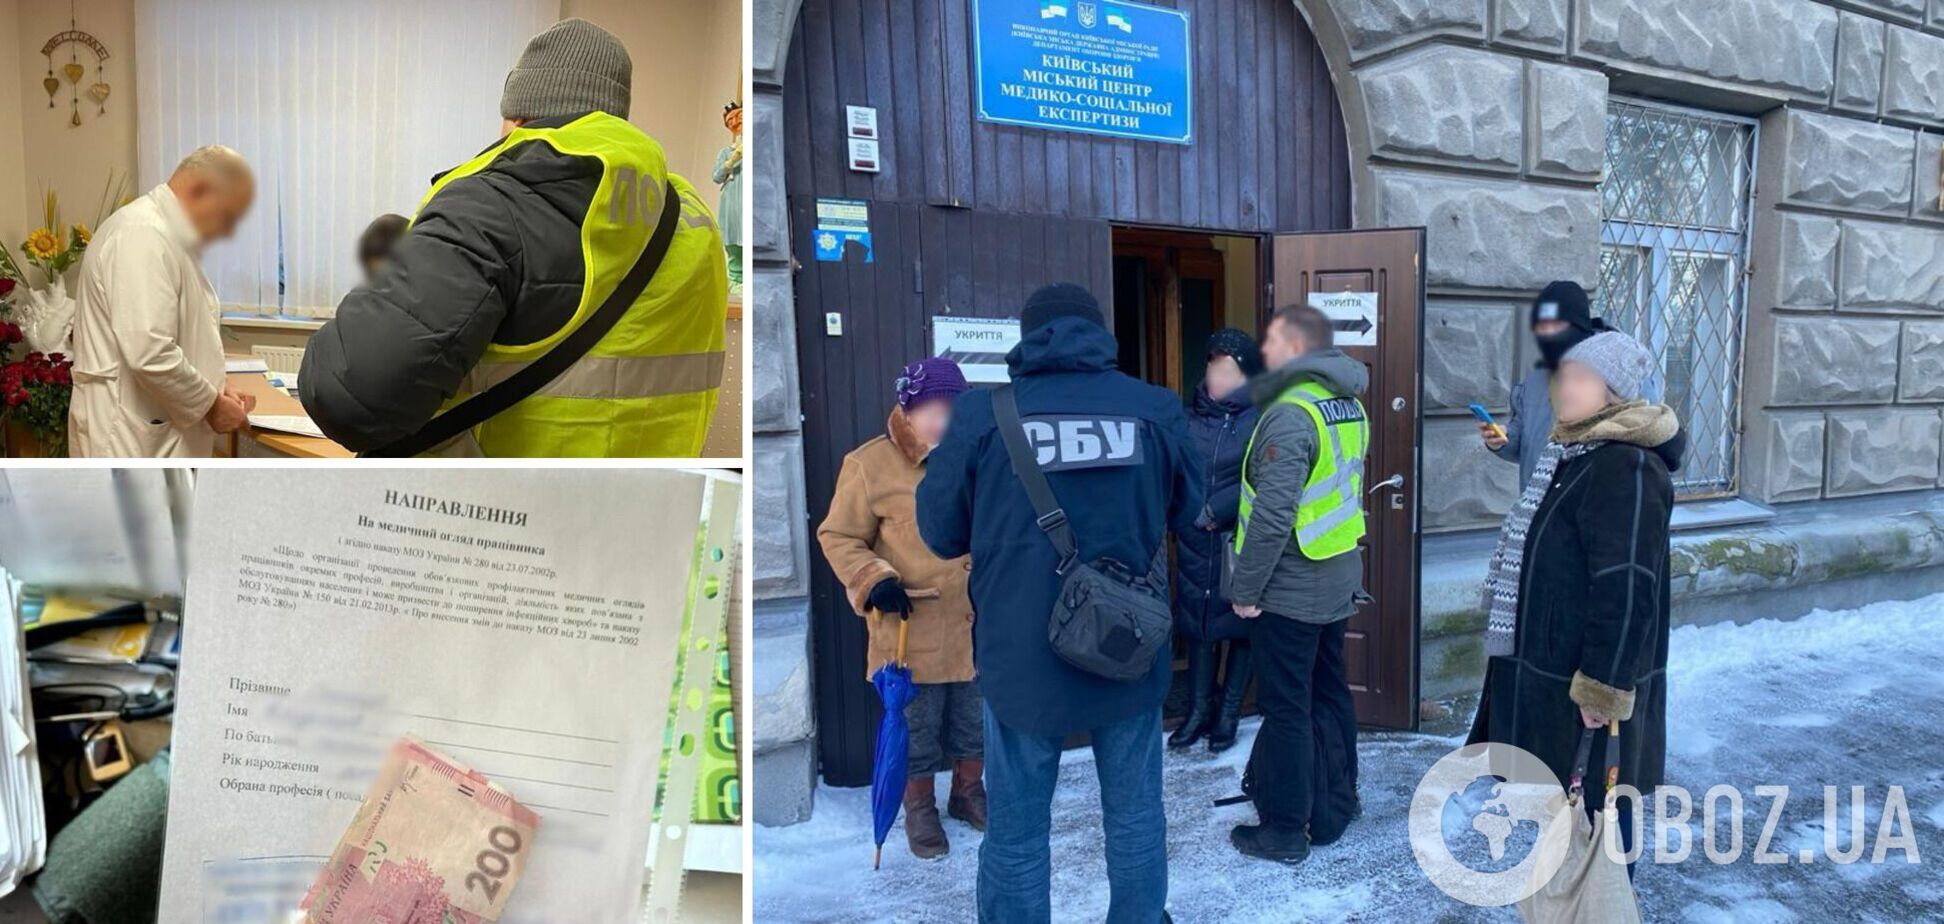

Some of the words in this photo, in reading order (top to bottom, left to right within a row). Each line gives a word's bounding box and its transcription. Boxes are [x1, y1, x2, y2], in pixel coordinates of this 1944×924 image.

[1024, 69, 1098, 90] МІСЬКИЙ
[1103, 80, 1152, 98] ЦЕНТР
[1042, 54, 1133, 79] КИЇВСЬКИЙ
[1001, 83, 1173, 117] МЕДИКО-СОЦІАЛЬНОЇ
[1039, 106, 1139, 129] ЕКСПЕРТИЗИ
[1323, 299, 1362, 308] УКРИТТЯ
[955, 330, 1003, 341] УКРИТТЯ
[1022, 420, 1135, 466] СБУ
[384, 489, 528, 527] НАПРАВЛЕННЯ
[358, 515, 374, 528] На
[378, 521, 437, 539] медичний
[440, 531, 474, 546] огляд
[477, 538, 545, 556] працівника
[345, 538, 371, 550] згідно
[373, 543, 401, 555] наказу
[403, 548, 424, 558] МОЗ
[426, 552, 460, 565] України
[462, 556, 473, 565] №
[474, 558, 489, 568] 280
[491, 562, 504, 571] від
[506, 563, 557, 579] 23.07.2002р.
[241, 554, 294, 570] працівників
[300, 564, 336, 577] окремих
[343, 571, 384, 586] професій,
[390, 580, 444, 595] виробництва
[515, 598, 558, 610] діяльність
[565, 605, 585, 614] яких
[273, 545, 304, 558] «Щодо
[312, 553, 359, 569] організації
[367, 562, 416, 577] проведення
[487, 581, 555, 597] профілактичних
[564, 592, 605, 604] медичних
[613, 599, 645, 610] оглядів
[238, 593, 259, 606] року
[260, 596, 270, 605] №
[239, 579, 261, 591] МОЗ
[264, 584, 299, 598] Україна
[302, 590, 313, 600] №
[316, 592, 331, 602] 150
[334, 595, 346, 605] від
[350, 598, 400, 616] 21.02.2013р.
[411, 607, 428, 620] Про
[431, 613, 468, 624] внесення
[472, 617, 490, 627] змін
[492, 620, 503, 630] до
[506, 623, 533, 634] наказу
[537, 624, 558, 636] МОЗ
[561, 629, 574, 638] від
[576, 630, 587, 640] 23
[590, 633, 615, 643] липня
[619, 636, 638, 646] 2002
[240, 567, 315, 587] обслуговуванням
[319, 581, 362, 595] населення
[372, 590, 394, 600] може
[398, 594, 439, 608] призвести
[442, 602, 453, 610] до
[456, 604, 503, 617] поширення
[507, 609, 563, 623] інфекційних
[600, 622, 610, 630] та
[612, 624, 640, 635] наказу
[227, 703, 248, 716] Імя
[225, 728, 243, 741] По
[246, 730, 284, 745] бать
[222, 752, 241, 766] Рік
[246, 758, 319, 773] народження
[220, 777, 265, 792] Обрана
[269, 781, 323, 797] професія
[465, 825, 522, 905] 200
[327, 862, 358, 920] УКРАЇНА
